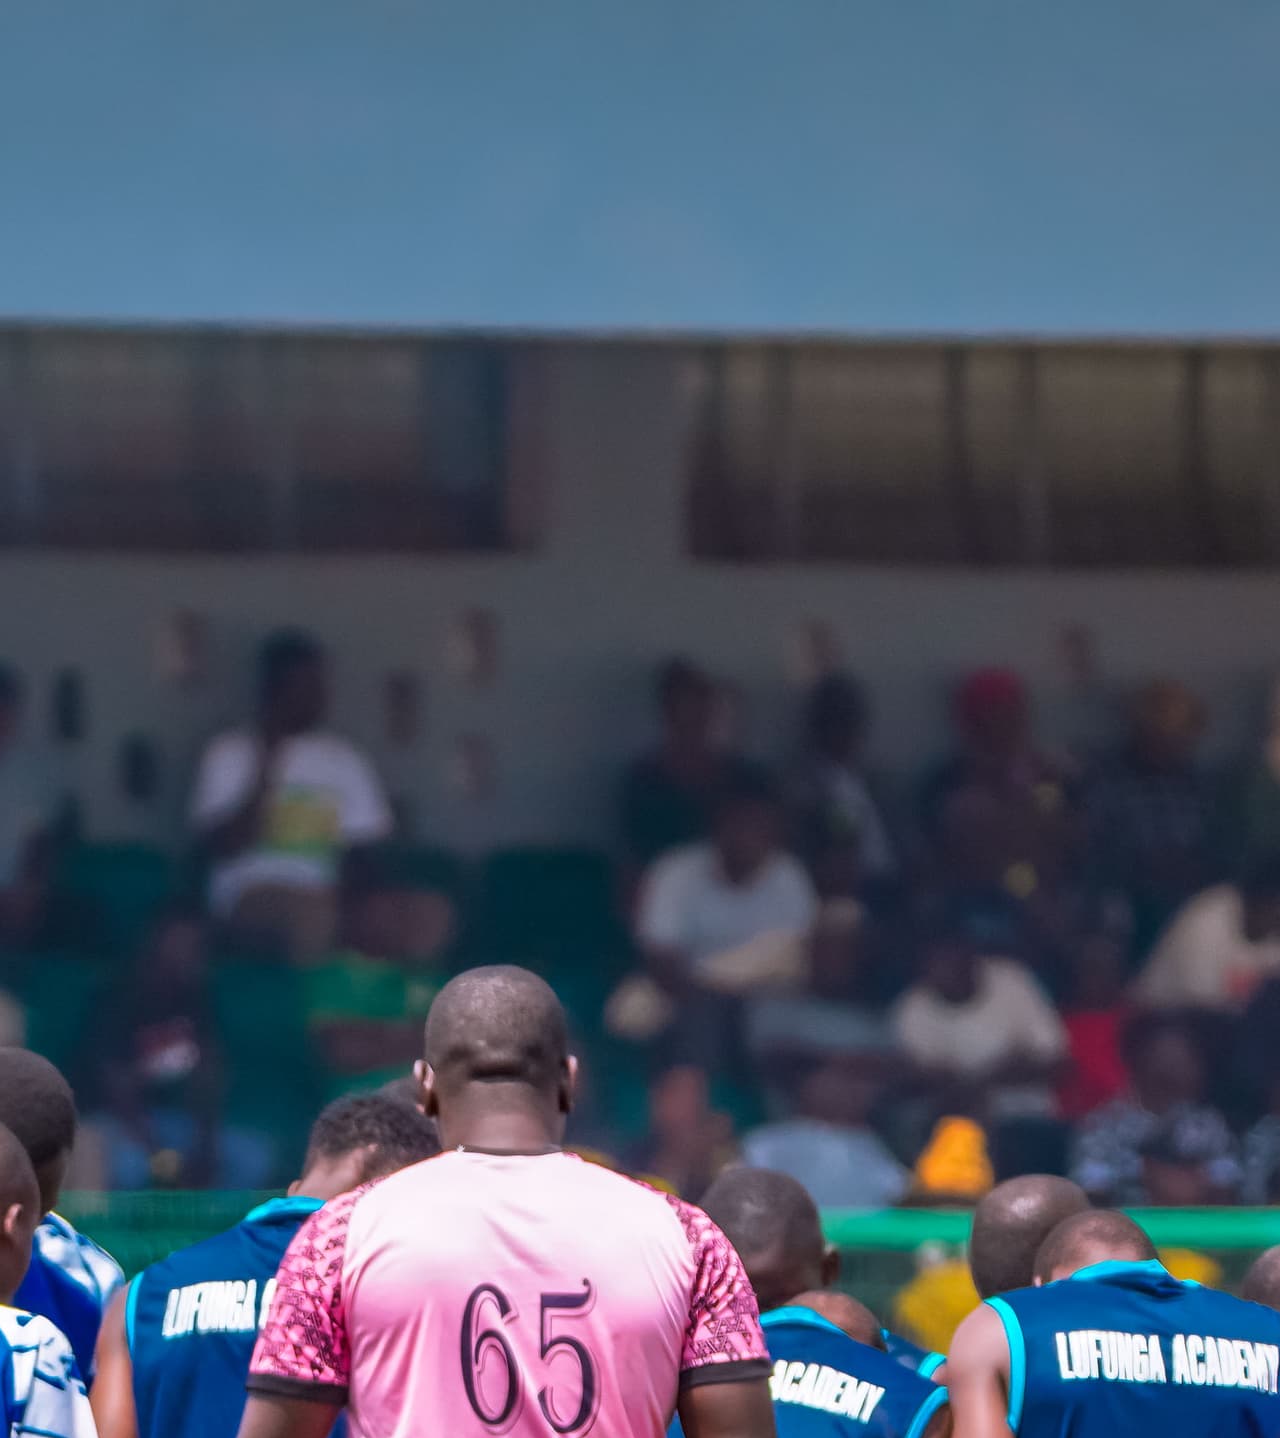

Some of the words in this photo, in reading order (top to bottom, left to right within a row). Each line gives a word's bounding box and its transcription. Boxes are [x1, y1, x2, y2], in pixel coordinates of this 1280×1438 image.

[162, 1279, 258, 1338] LUFUNGA
[1055, 1330, 1167, 1384] LUFUNGA
[1172, 1334, 1280, 1395] ACADEMY
